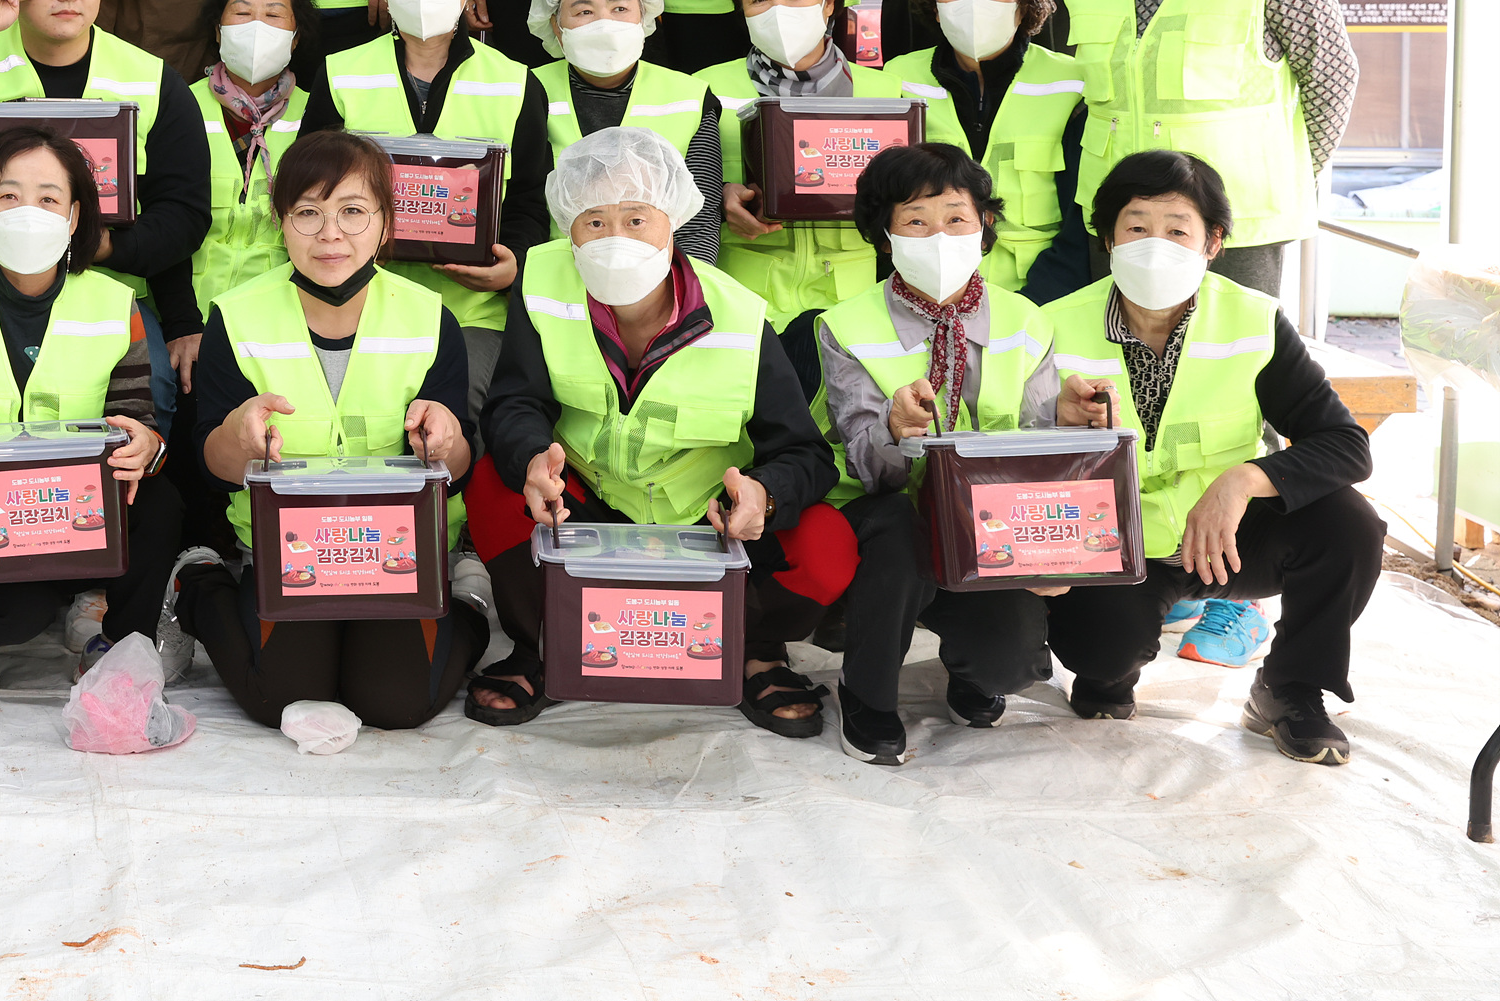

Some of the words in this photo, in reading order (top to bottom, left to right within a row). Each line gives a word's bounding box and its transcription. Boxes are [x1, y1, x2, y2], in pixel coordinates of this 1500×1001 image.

[822, 138, 880, 151] 사랑나눔
[392, 182, 449, 198] 사랑나눔
[393, 199, 447, 216] 김장김치
[5, 487, 70, 506] 사랑나눔
[8, 506, 70, 526] 김장김치
[1010, 504, 1081, 522] 사랑나눔
[314, 527, 381, 544] 사랑나눔
[1013, 524, 1081, 543] 김장김치
[317, 547, 380, 564] 김장김치
[617, 610, 687, 627] 사랑나눔
[619, 630, 685, 648] 김장김치
